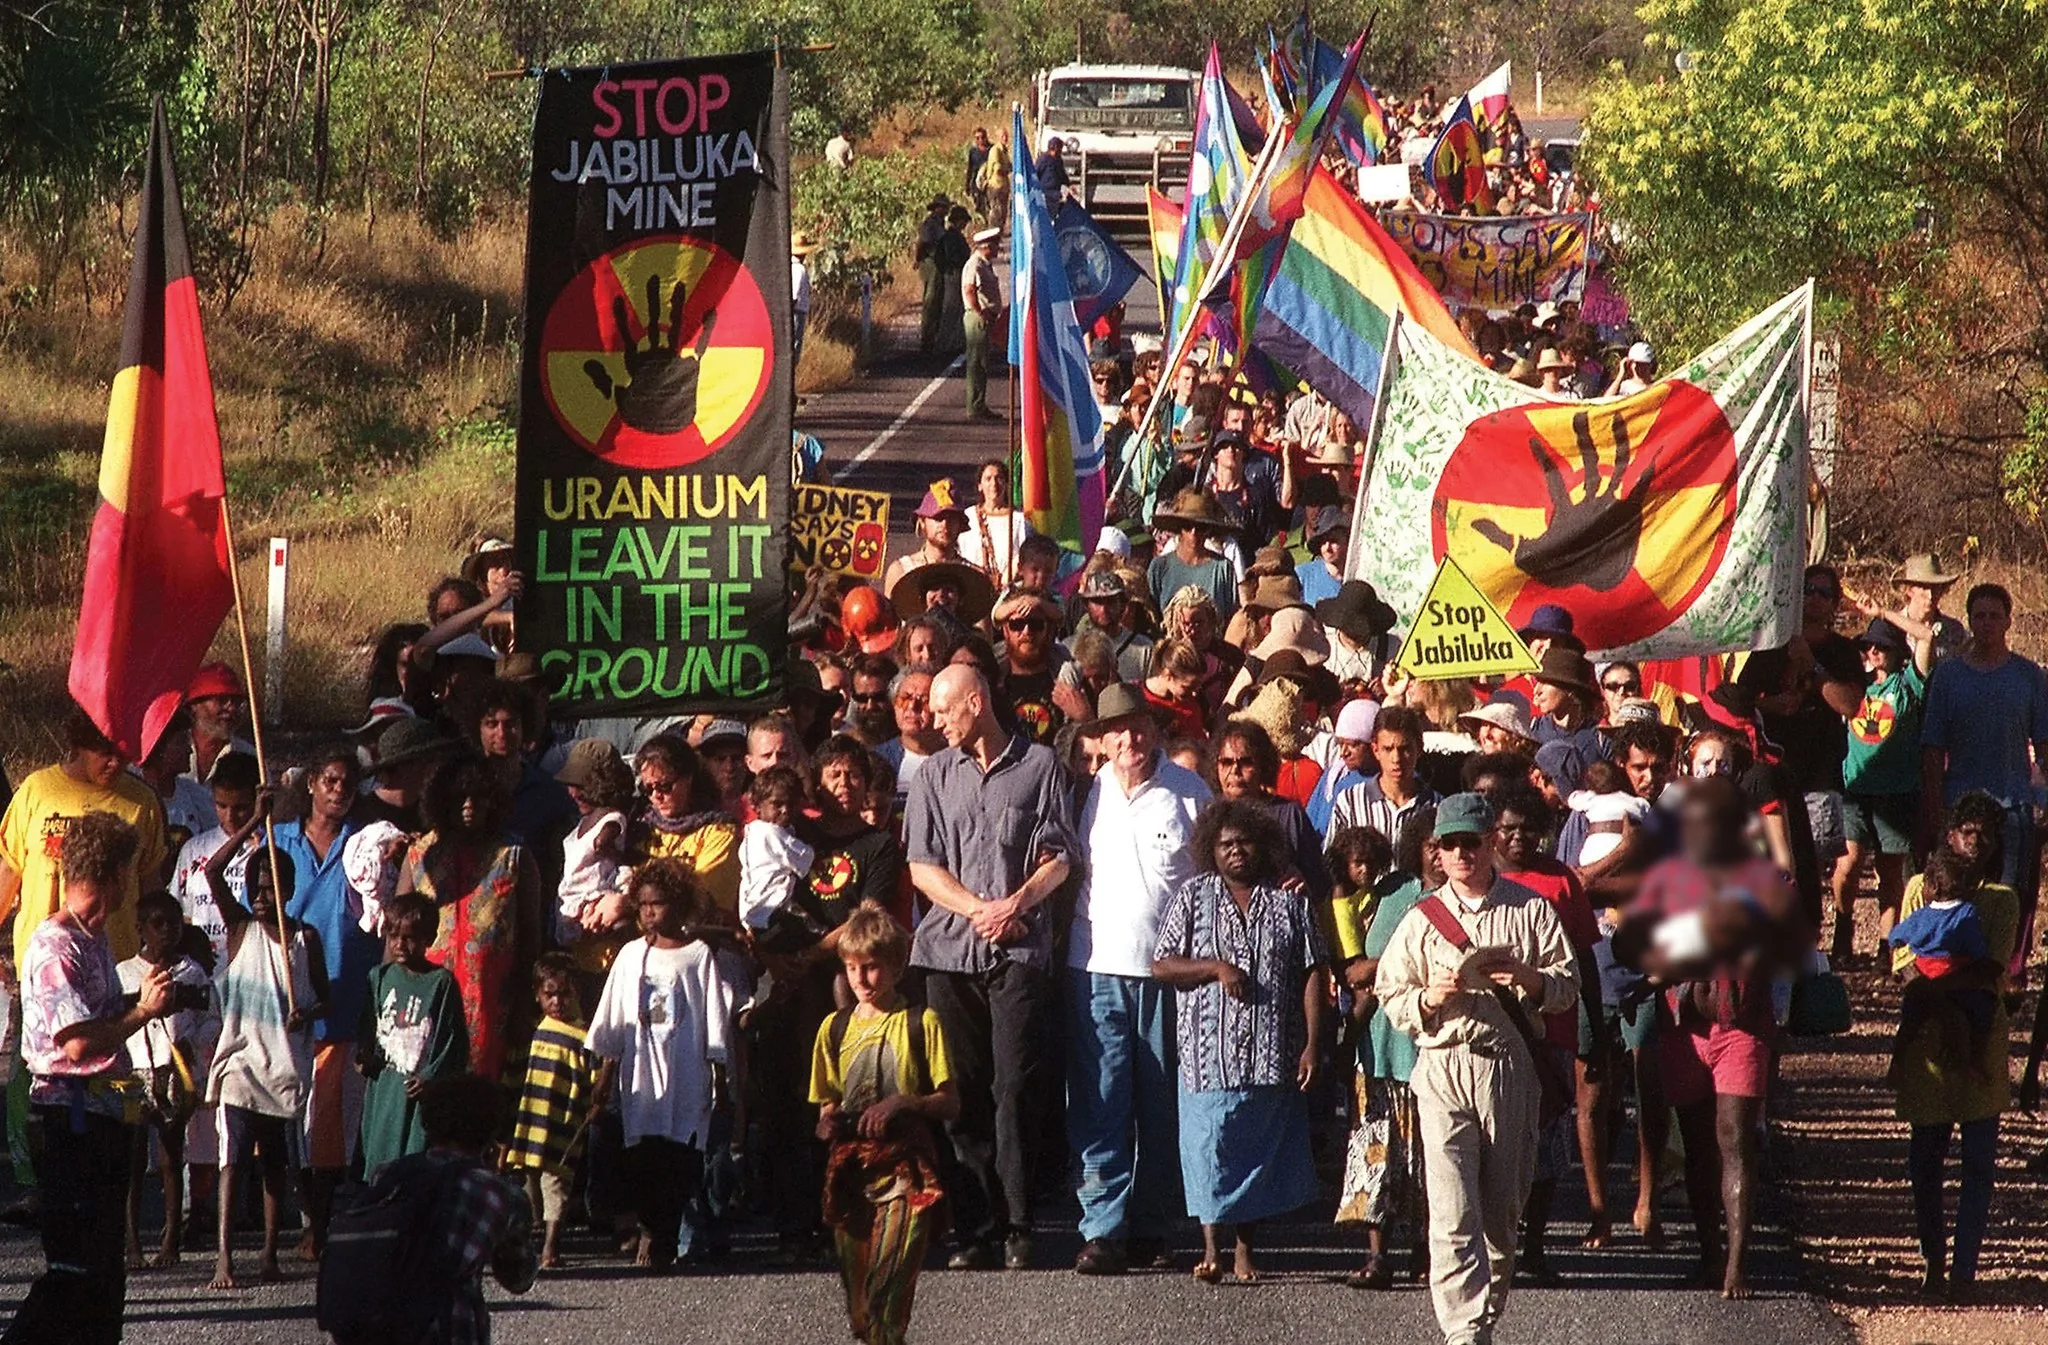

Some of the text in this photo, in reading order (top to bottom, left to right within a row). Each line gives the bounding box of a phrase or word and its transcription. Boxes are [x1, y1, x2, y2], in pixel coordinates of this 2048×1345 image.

[592, 74, 730, 138] STOP
[551, 129, 764, 185] JABILUKA
[606, 182, 717, 230] MINE
[543, 475, 767, 521] URANIUM
[790, 487, 885, 520] YDNEY
[792, 513, 854, 539] SAYS
[536, 525, 772, 582] LEAVE IT
[566, 583, 752, 643] IN THE
[1427, 600, 1486, 632] Stop
[541, 643, 772, 700] GROUND
[1412, 632, 1514, 667] Jabiluka
